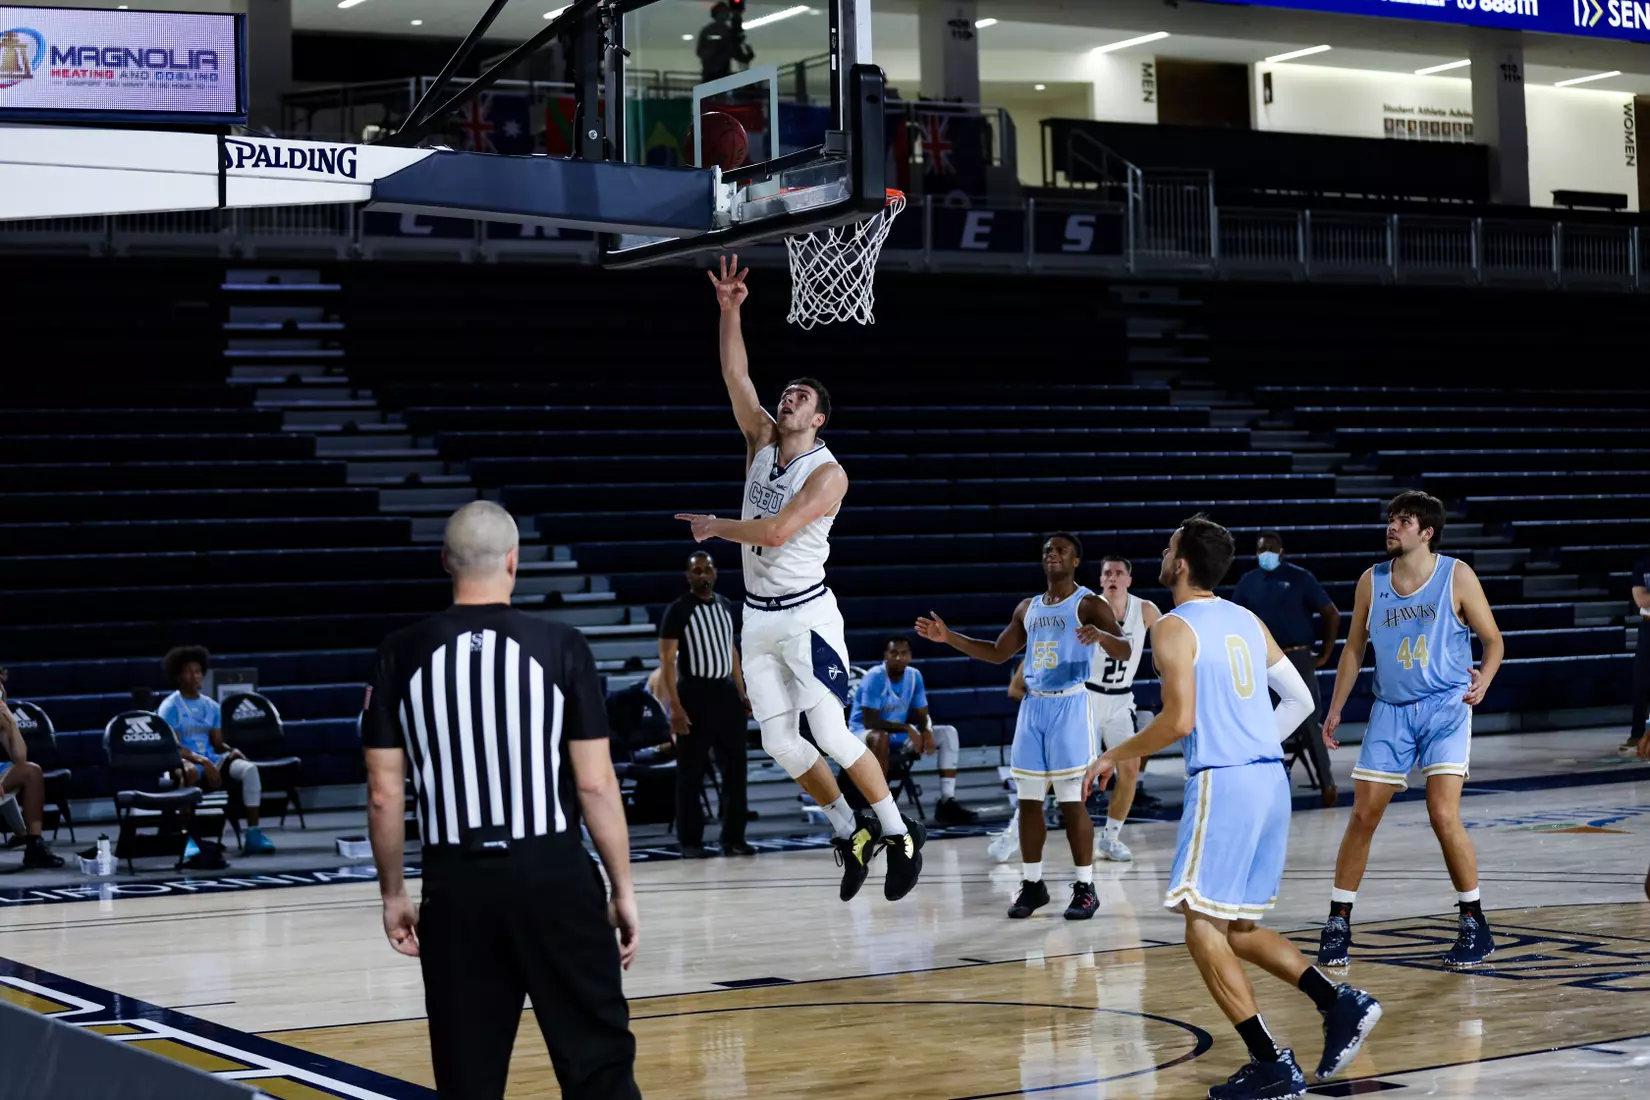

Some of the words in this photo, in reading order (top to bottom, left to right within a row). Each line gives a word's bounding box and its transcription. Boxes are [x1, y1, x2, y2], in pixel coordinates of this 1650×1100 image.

[51, 45, 219, 70] MAGNOLIA
[50, 68, 114, 80] HEATING
[120, 70, 150, 81] AND
[1141, 62, 1155, 103] MEN
[1383, 103, 1414, 114] Student
[1418, 105, 1447, 117] Athlete
[1623, 102, 1636, 167] WOMEN
[749, 480, 785, 515] CBU
[1028, 615, 1068, 633] HAWKS
[1377, 603, 1439, 629] HAWKS
[1033, 640, 1059, 670] 55
[1397, 634, 1430, 670] 44
[1101, 658, 1128, 684] 25
[1224, 634, 1256, 699] 0
[232, 708, 266, 720] adidas
[122, 731, 162, 742] adidas
